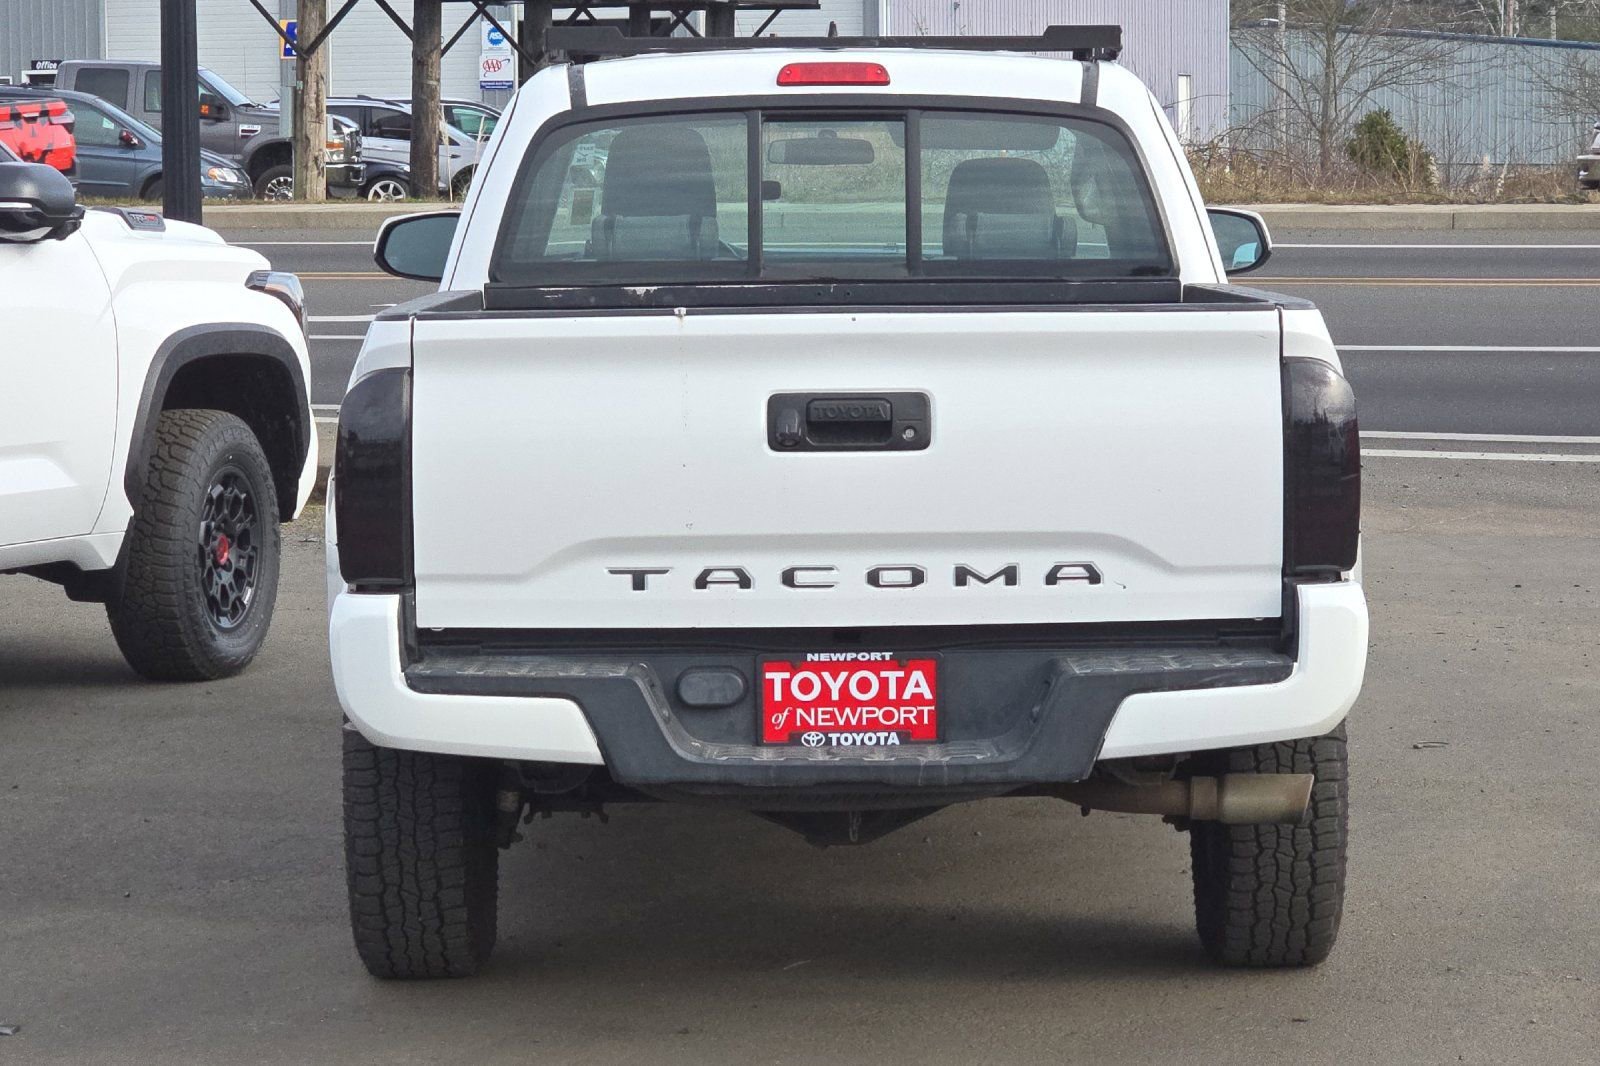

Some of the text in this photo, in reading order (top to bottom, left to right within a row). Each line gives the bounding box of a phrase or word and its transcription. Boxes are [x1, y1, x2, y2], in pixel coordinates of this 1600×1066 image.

[36, 61, 57, 70] Office
[484, 60, 502, 72] AAA
[813, 404, 886, 419] TOYOTA
[606, 561, 1104, 592] TACOMA
[806, 652, 893, 662] NEWPORT
[765, 670, 933, 701] TOYOTA
[771, 706, 935, 730] of NEWPORT
[828, 732, 900, 746] TOYOTA
